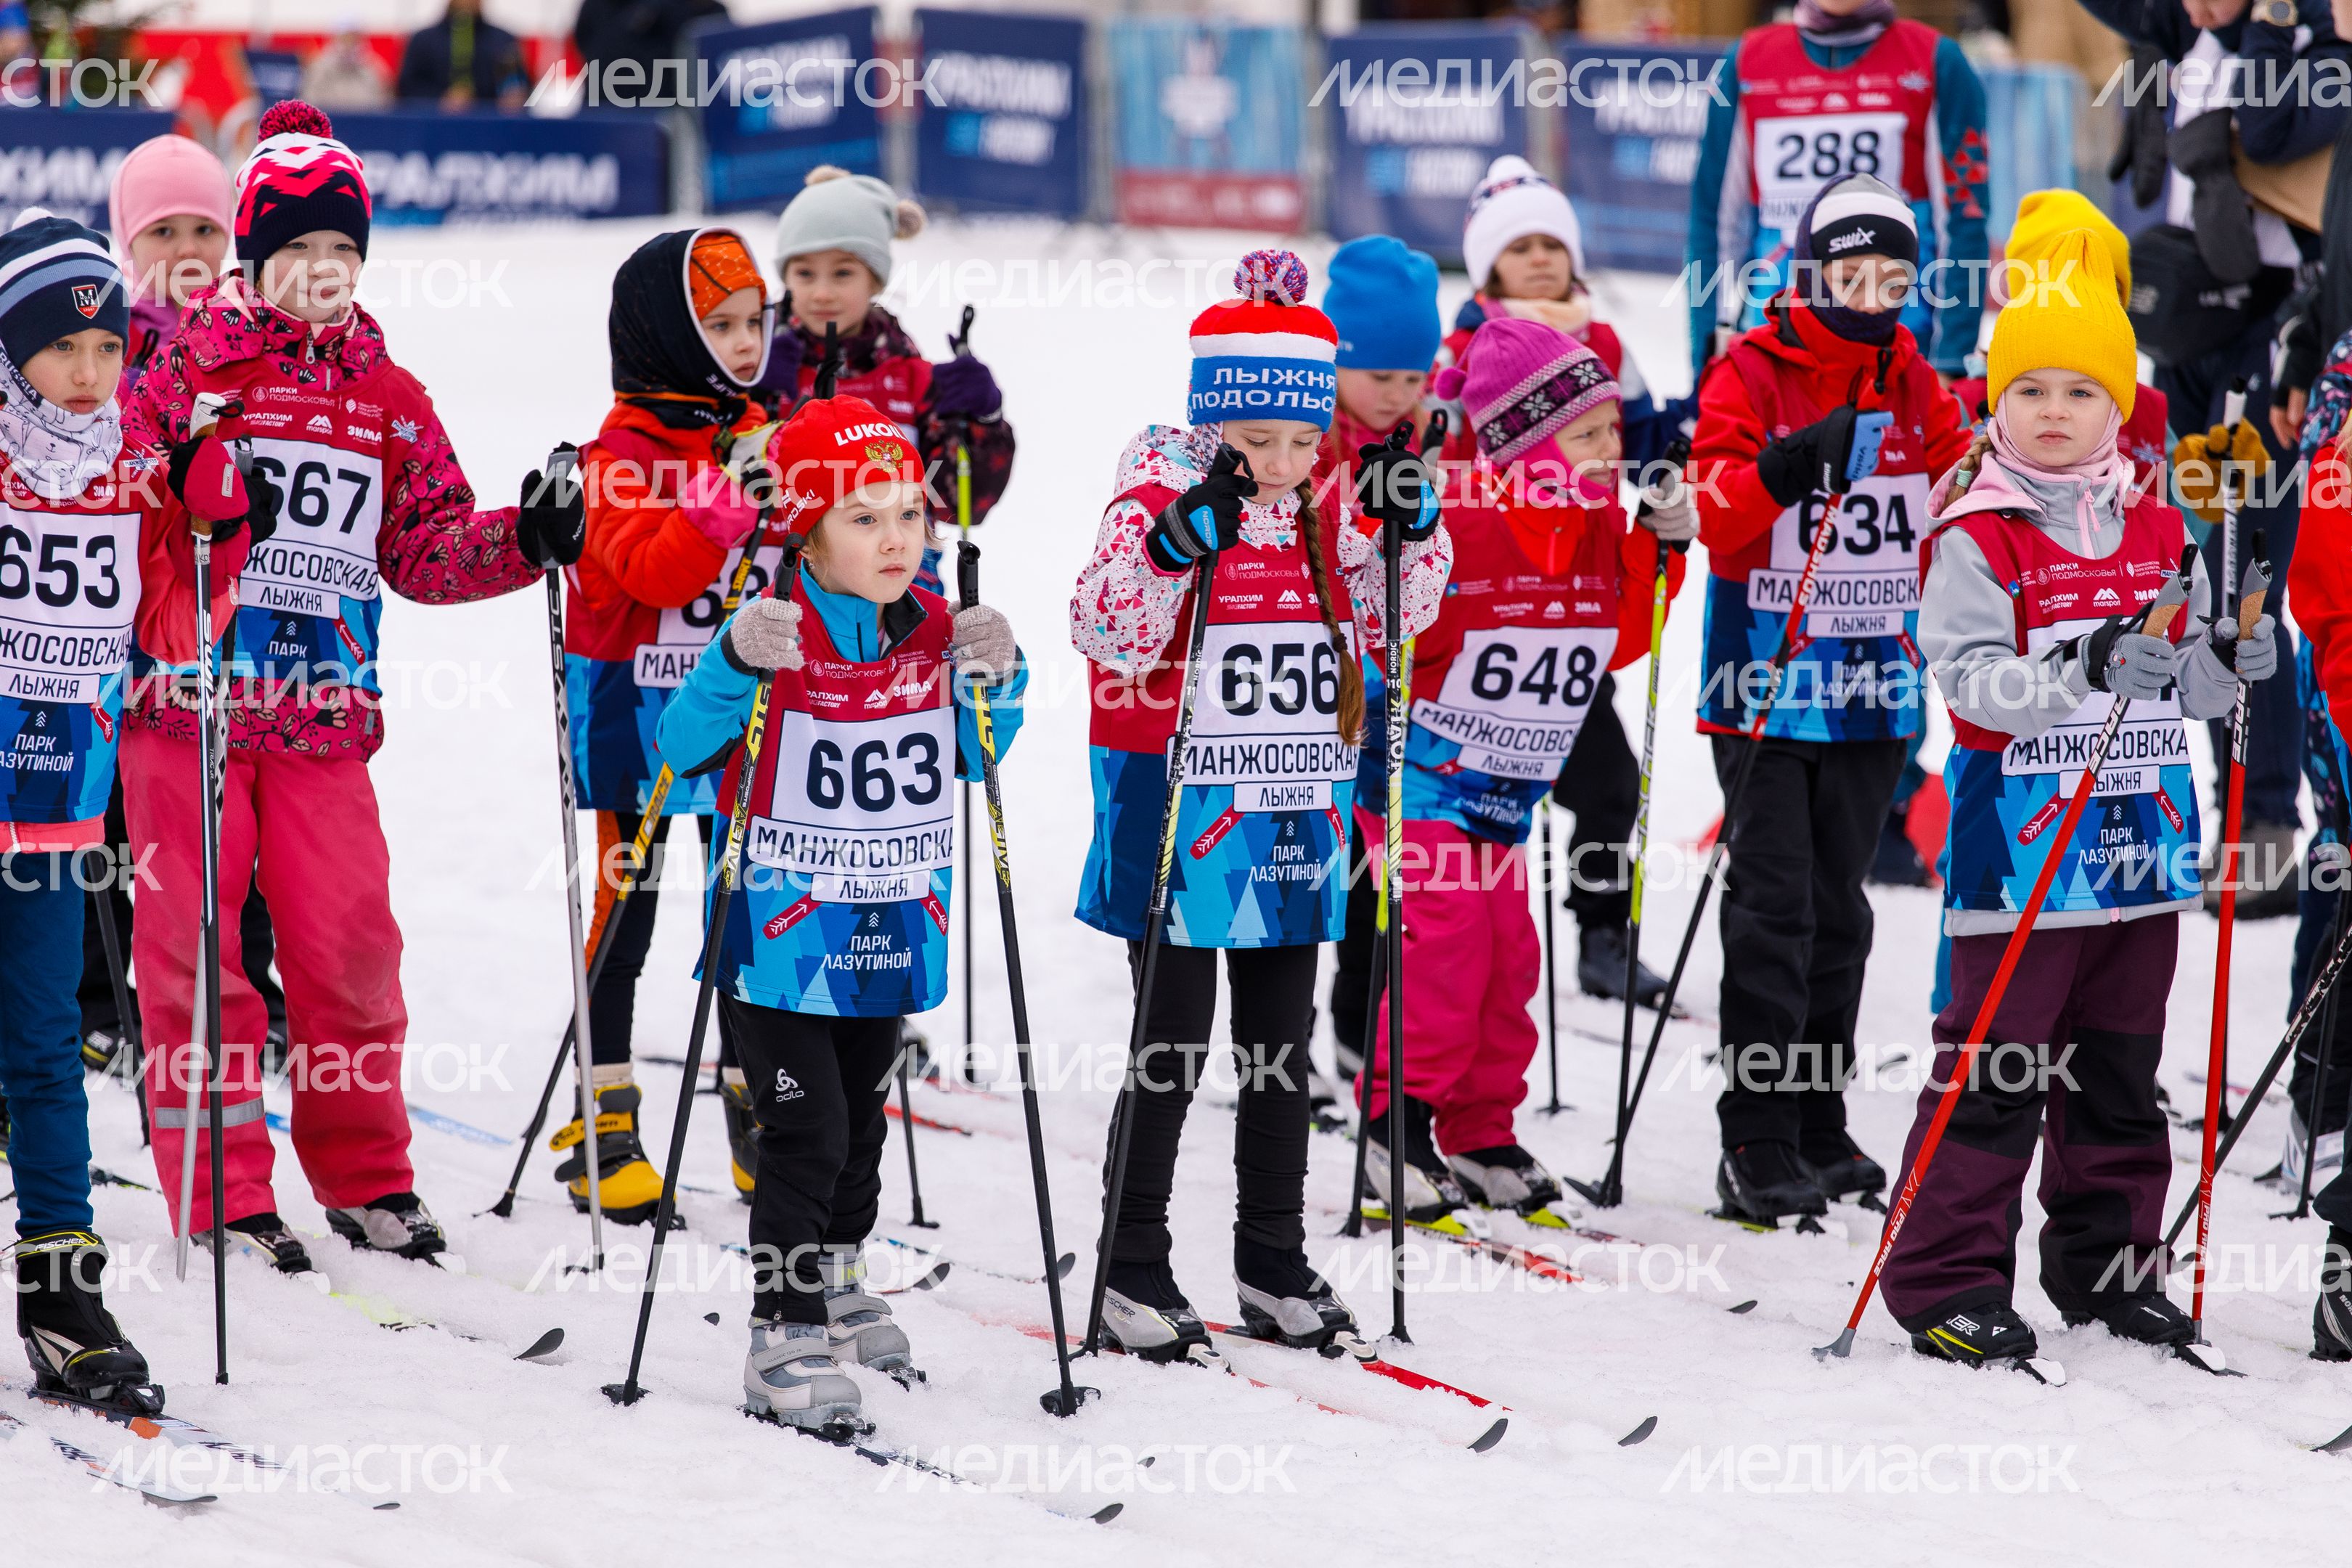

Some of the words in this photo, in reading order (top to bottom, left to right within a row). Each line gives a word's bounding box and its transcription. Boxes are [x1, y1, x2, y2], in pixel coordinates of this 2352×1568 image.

[1778, 131, 1880, 178] 288
[1829, 226, 1876, 253] SWIX
[0, 352, 38, 401] RUSSIA
[1214, 367, 1336, 390] ЛЫЖНЯ
[269, 393, 335, 407] ПОДМОСКОВЬЯ
[242, 412, 293, 422] УРАЛХИМ
[348, 425, 382, 443] ЗИМА
[834, 422, 907, 446] LUKOIL
[1798, 494, 1915, 555] 634
[0, 524, 120, 608] 653
[1238, 563, 1265, 571] ПАРКИ
[1238, 569, 1300, 580] ПОДМОСКОВЬЯ
[2050, 563, 2078, 571] ПАРКИ
[2051, 569, 2116, 580] ПОДМОСКОВЬЯ
[260, 587, 322, 612] ЛЫЖНЯ
[1218, 595, 1263, 603] УРАЛХИМ
[2093, 599, 2121, 608] marsport
[1830, 616, 1886, 633] ЛЫЖНЯ
[269, 641, 307, 658] ПАРК
[825, 662, 853, 671] ПАРКИ
[1471, 643, 1596, 706] 648
[9, 674, 79, 698] ЛЫЖНЯ
[893, 681, 932, 698] ЗИМА
[1222, 642, 1339, 716] 656
[2231, 679, 2247, 762] RACE
[16, 733, 56, 752] ПАРК
[807, 732, 942, 812] 663
[1482, 755, 1544, 777] ЛЫЖНЯ
[2091, 771, 2141, 793] ЫЖНЯ
[1259, 786, 1314, 807] ЛЫЖНЯ
[2101, 827, 2133, 844] ПАРК
[1273, 845, 1304, 862] ПАРК
[2078, 839, 2150, 865] ЛАЗУТИНОЙ
[1249, 858, 1321, 883] ЛАЗУТИНОЙ
[839, 878, 908, 899] ЛЫЖНЯ
[851, 935, 891, 951] ПАРК
[822, 947, 912, 971] ЛАЗУТИНОЙ
[776, 1090, 804, 1102] odlo
[35, 1238, 86, 1251] FISCHER
[1103, 1294, 1135, 1318] FISCHER
